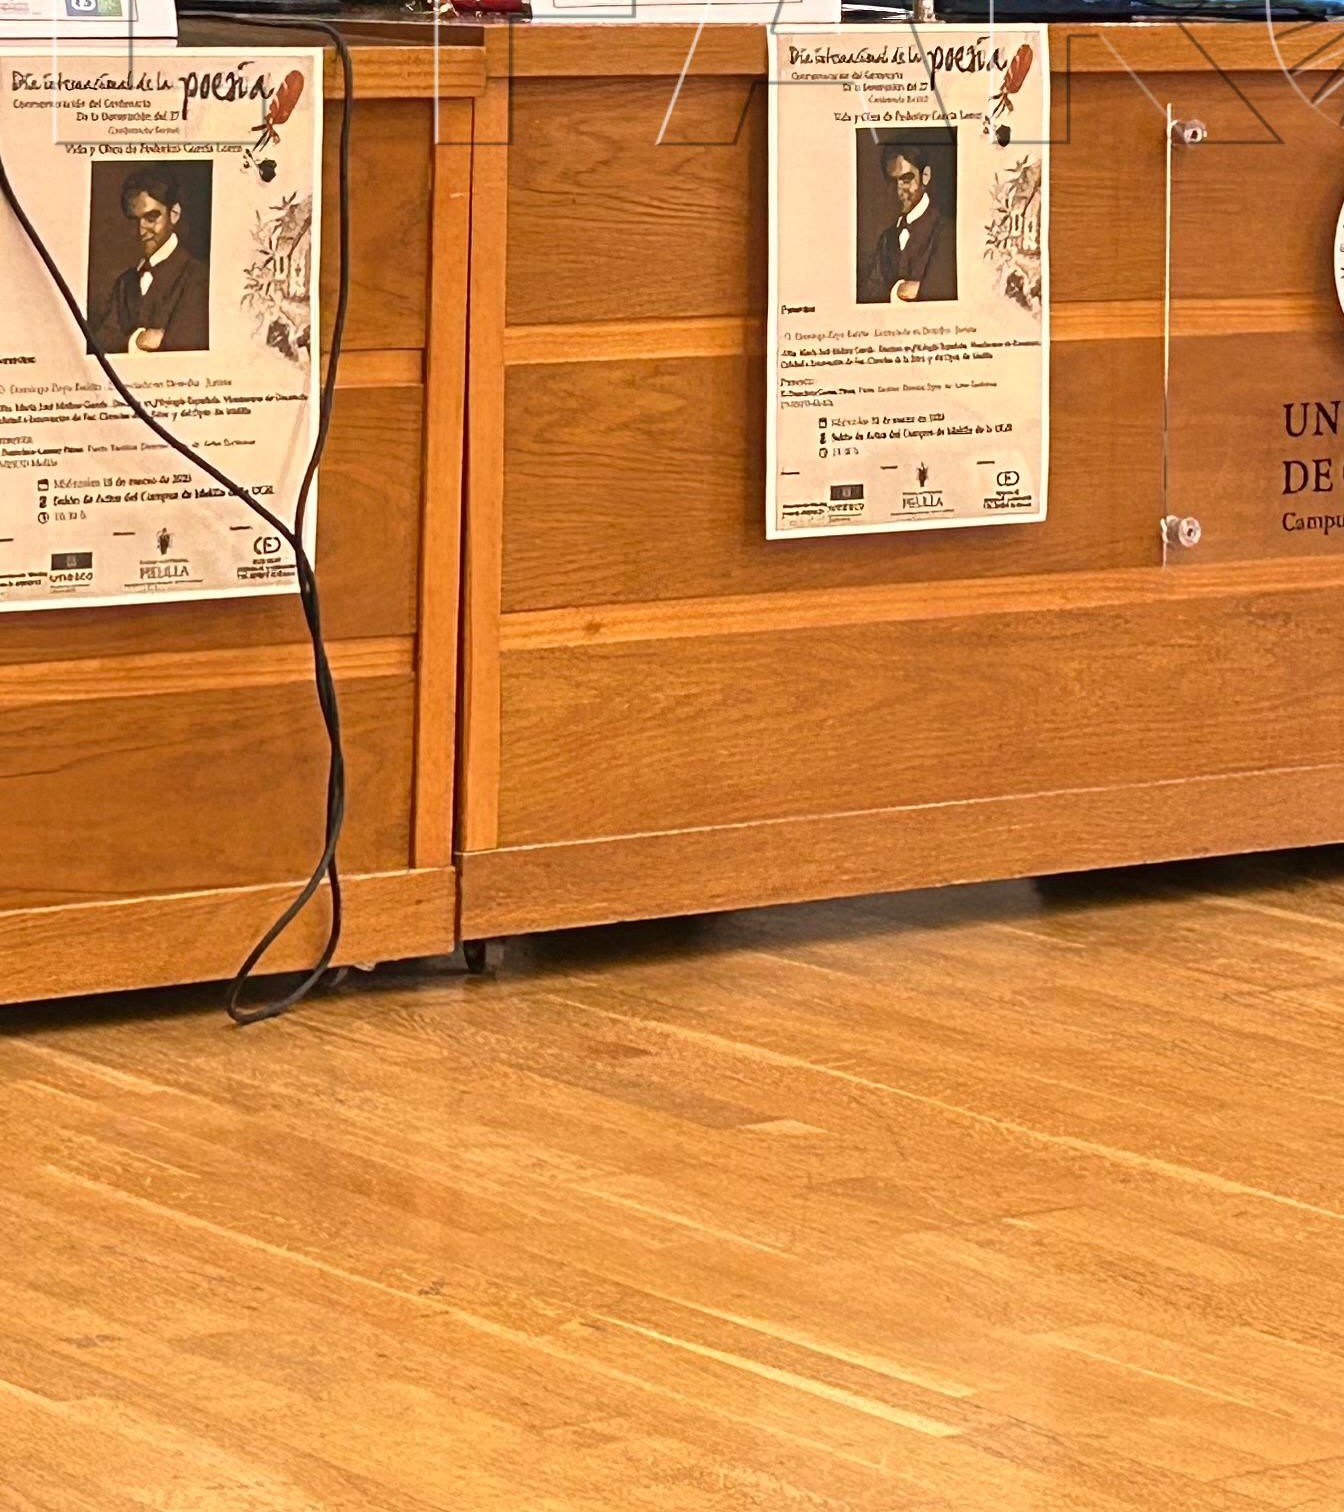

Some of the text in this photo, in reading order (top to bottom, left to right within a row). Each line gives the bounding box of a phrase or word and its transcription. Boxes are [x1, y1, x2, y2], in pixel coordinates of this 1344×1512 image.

[178, 61, 275, 121] poesía
[927, 36, 1009, 92] poesía
[1281, 458, 1334, 496] DE
